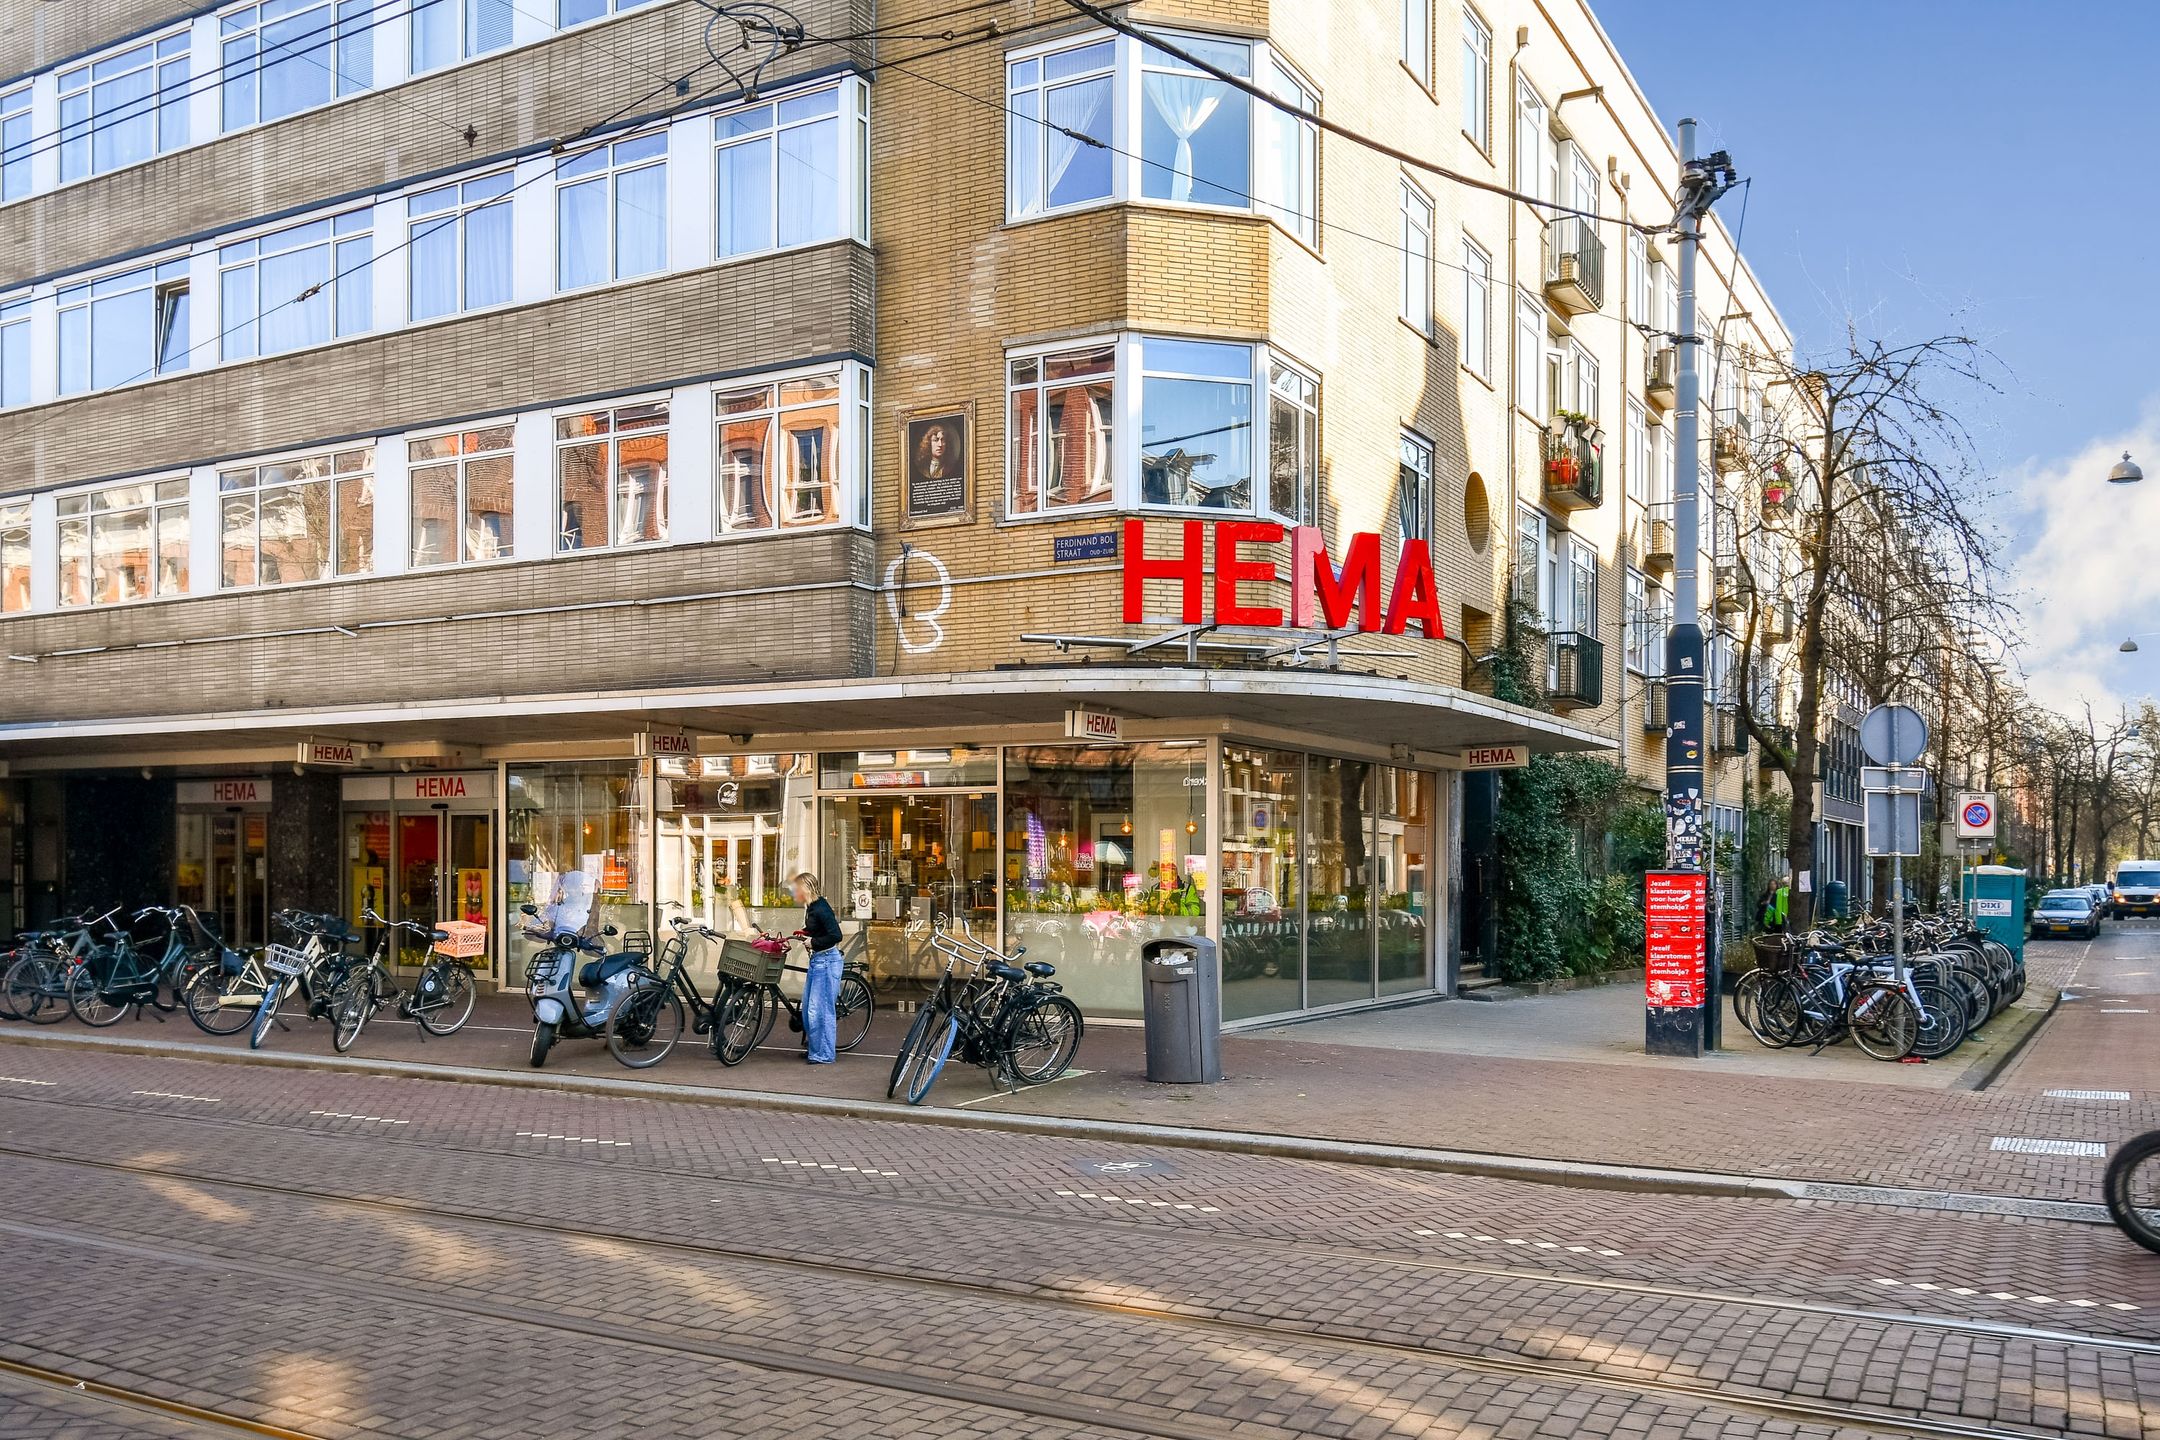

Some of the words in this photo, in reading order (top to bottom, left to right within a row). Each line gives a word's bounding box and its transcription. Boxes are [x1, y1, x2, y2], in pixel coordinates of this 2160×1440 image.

[1056, 536, 1098, 549] FERDINAND
[1100, 535, 1115, 545] BOL
[1056, 548, 1082, 559] STRAAT
[1123, 518, 1445, 639] HEMA
[1086, 714, 1117, 734] HEMA
[653, 735, 690, 752] HEMA
[314, 746, 354, 761] HEMA
[1469, 749, 1516, 764] HEMA
[214, 782, 257, 801] HEMA
[416, 777, 466, 797] HEMA
[1650, 880, 1671, 888] Jezelf
[1650, 887, 1692, 895] klaarstomen
[1650, 904, 1690, 912] stemhokje?
[1650, 944, 1671, 952] Jezelf
[1650, 952, 1692, 960] klaarstomen
[1650, 968, 1690, 977] stemhokje?
